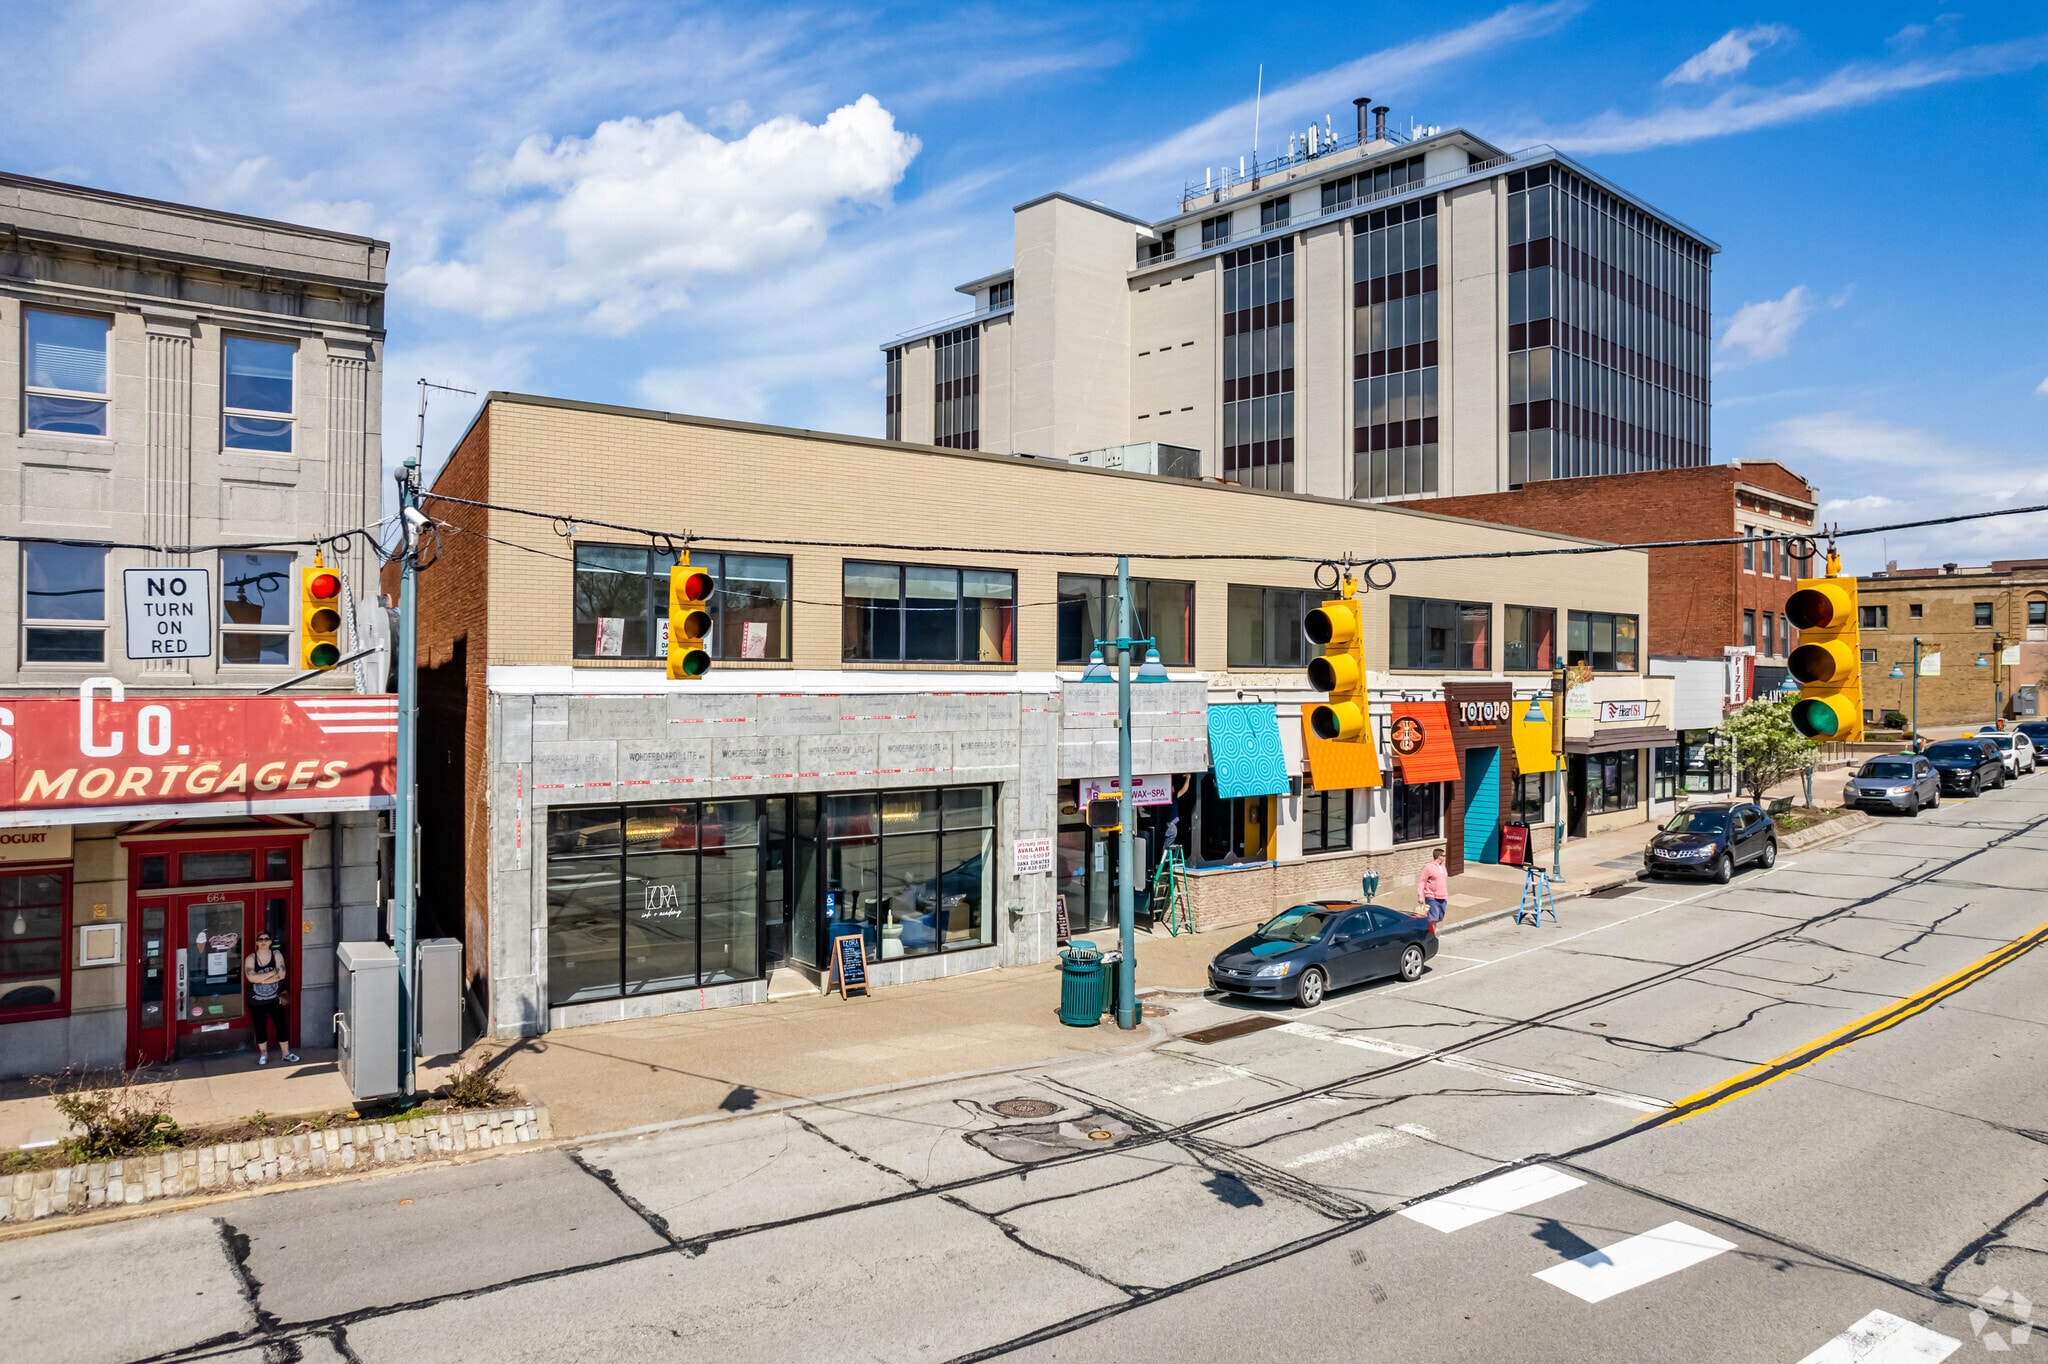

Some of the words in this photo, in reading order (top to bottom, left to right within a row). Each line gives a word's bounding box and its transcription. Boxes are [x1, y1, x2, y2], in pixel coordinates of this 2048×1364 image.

[147, 577, 187, 596] NO
[143, 602, 193, 617] TURN
[157, 620, 182, 635] ON
[152, 639, 187, 653] RED
[79, 676, 190, 758] Co.
[1459, 701, 1510, 722] TOTOPO
[20, 759, 349, 803] MORTGAGES
[1017, 846, 1050, 854] AVAILABLE
[207, 894, 226, 902] 664
